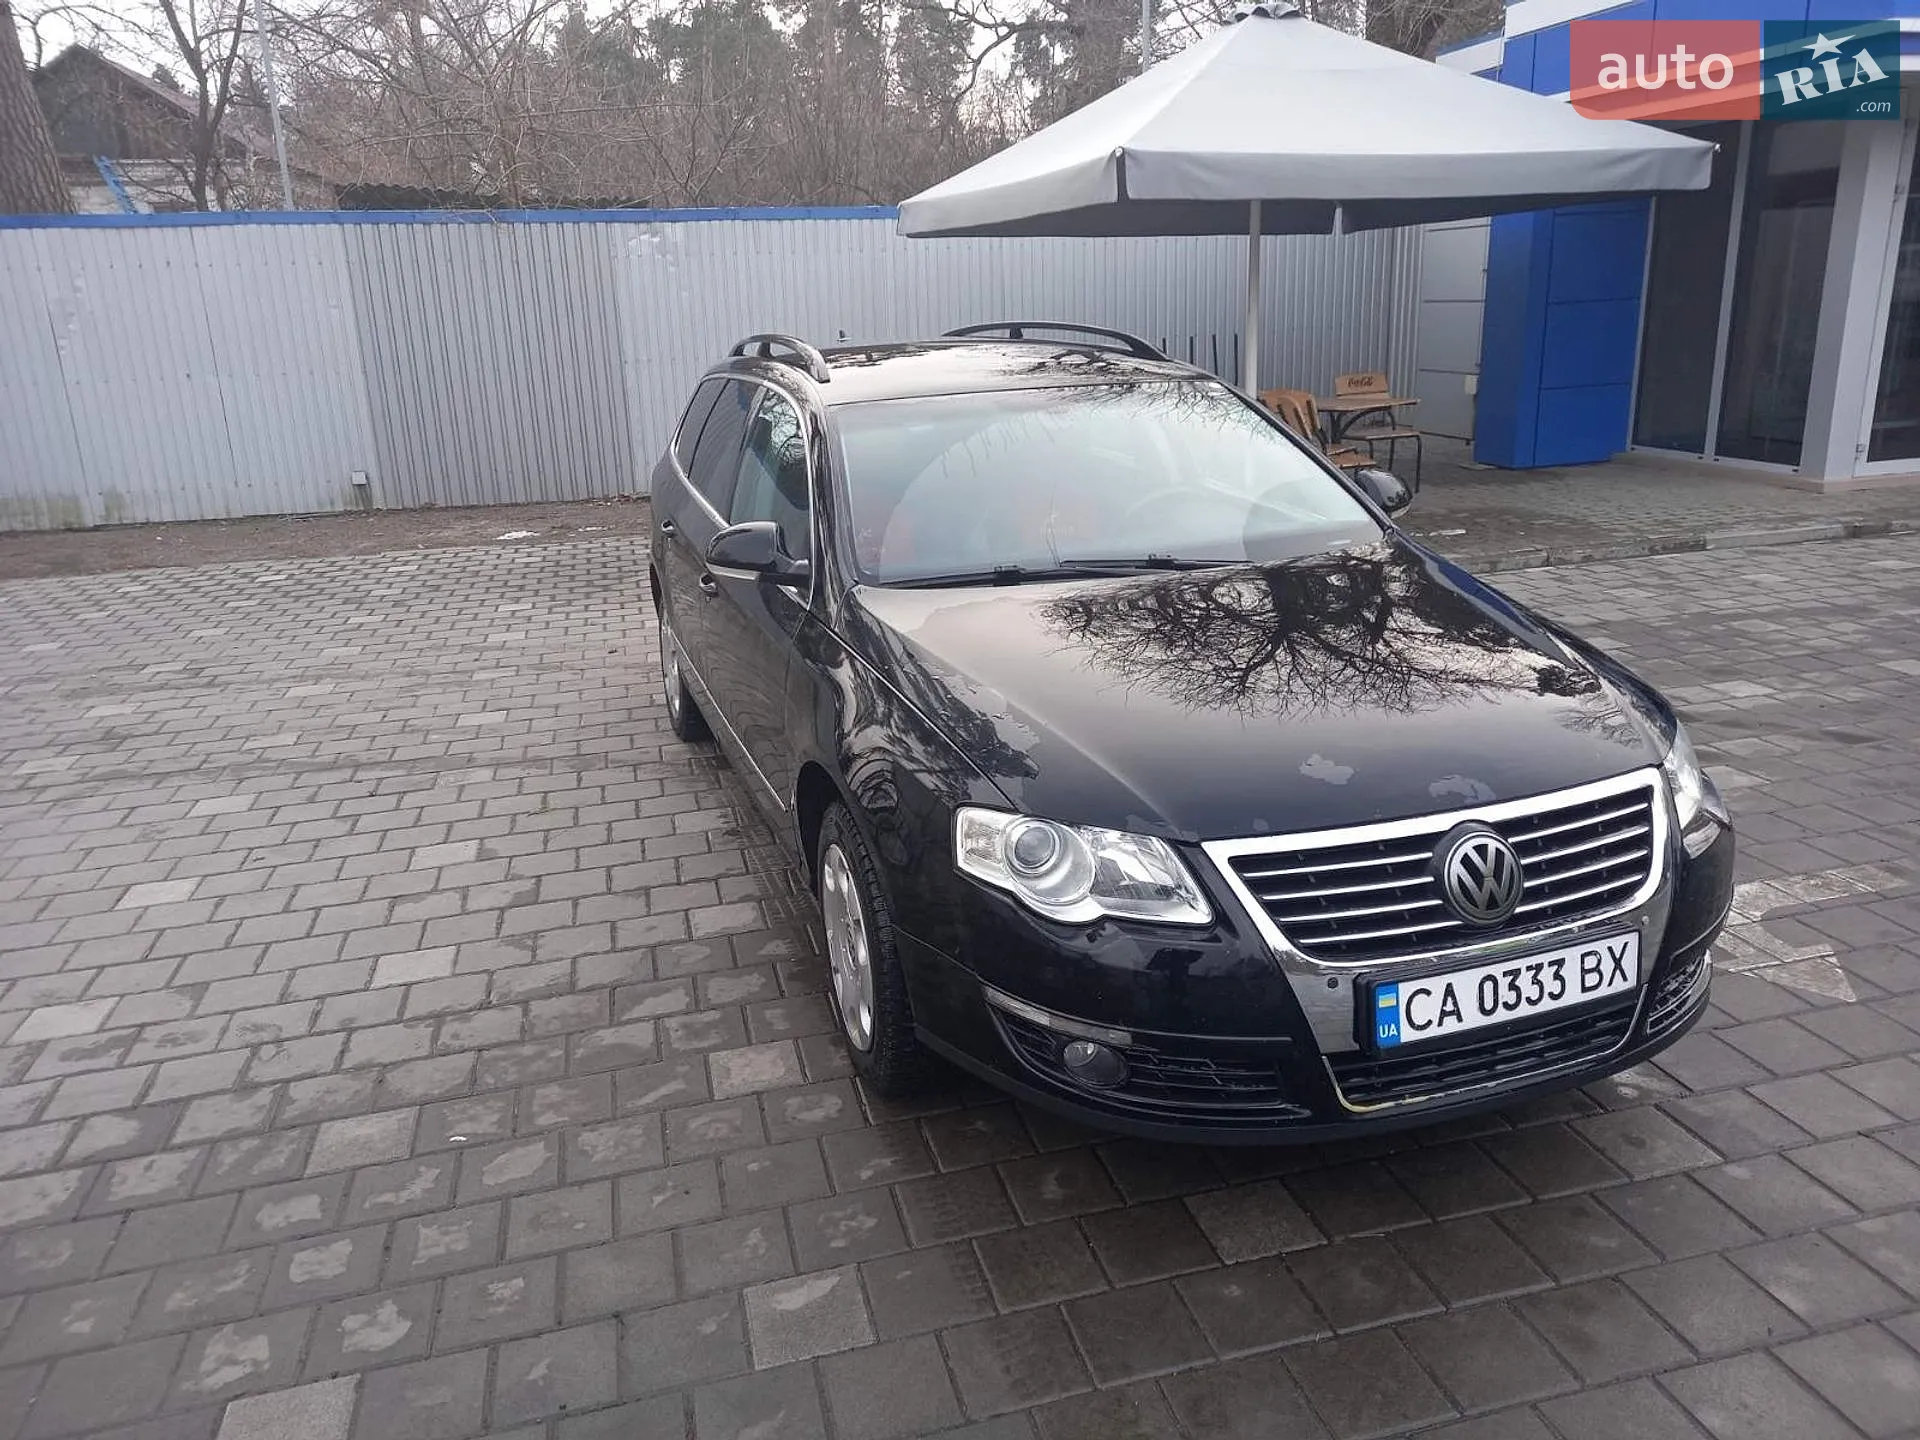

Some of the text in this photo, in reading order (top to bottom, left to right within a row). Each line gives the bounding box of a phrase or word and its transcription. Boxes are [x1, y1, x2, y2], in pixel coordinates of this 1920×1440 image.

[1404, 941, 1629, 1031] CA 0333 BX
[1379, 1024, 1398, 1038] UA
